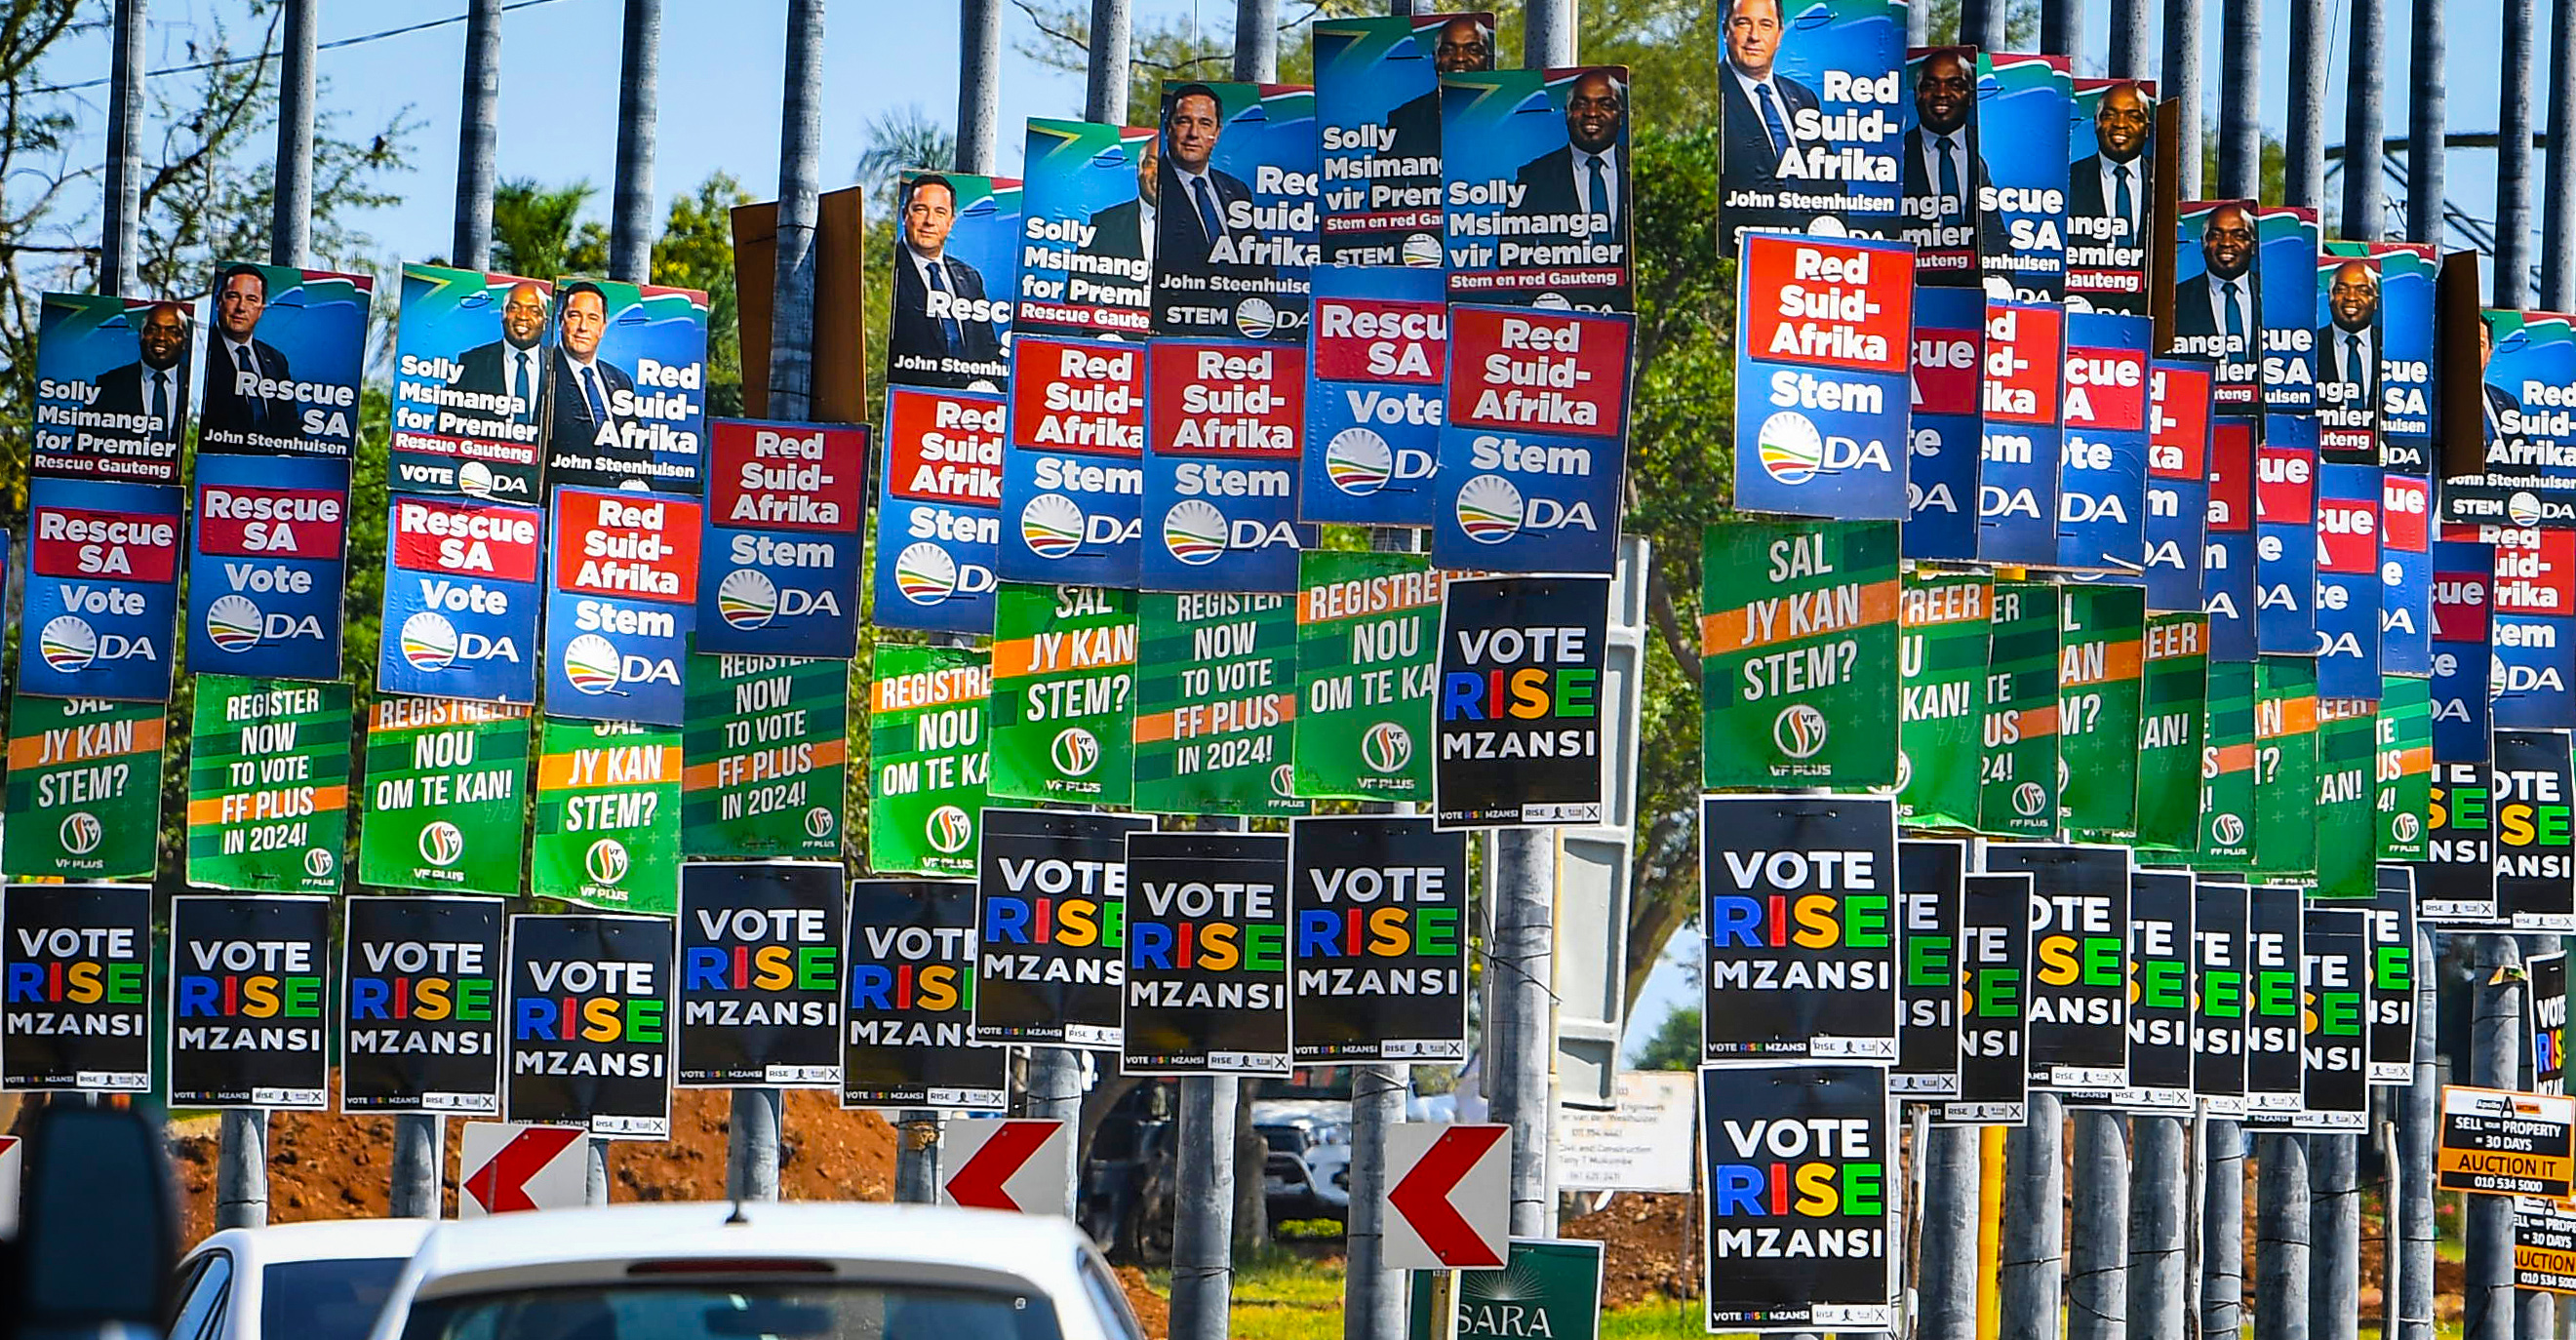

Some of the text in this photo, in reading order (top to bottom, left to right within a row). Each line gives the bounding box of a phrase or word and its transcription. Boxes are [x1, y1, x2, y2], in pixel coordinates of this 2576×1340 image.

[1823, 70, 1899, 103] Red
[1323, 125, 1397, 151] Solly
[1794, 108, 1898, 141] Suid-
[1775, 146, 1897, 181] Afrika
[1325, 187, 1366, 212] vir
[1448, 179, 1527, 210] Solly
[1725, 190, 1895, 213] John Steenhuisen
[1025, 217, 1097, 245] Solly
[1449, 212, 1609, 238] Msimanga
[2009, 219, 2063, 251] SA
[1450, 242, 1624, 268] vir Premier
[1022, 277, 1064, 299] for
[1450, 272, 1617, 290] Stem en red Gauteng
[1020, 302, 1090, 324] Rescue
[1166, 306, 1228, 325] STEM
[1500, 318, 1581, 354] Red
[400, 355, 464, 383] Solly
[636, 358, 701, 391] Red
[1060, 349, 1133, 380] Red
[1197, 350, 1273, 381] Red
[1366, 341, 1433, 377] SA
[1483, 353, 1591, 389] Suid-
[2263, 356, 2313, 386] SA
[39, 378, 100, 405] Solly
[234, 372, 354, 407] Rescue
[398, 381, 526, 416] Msimanga
[611, 389, 699, 422] Suid-
[1182, 383, 1286, 415] Suid-
[2384, 387, 2428, 415] SA
[38, 406, 163, 437] Msimanga
[302, 408, 351, 438] SA
[1472, 389, 1598, 426] Afrika
[203, 428, 346, 454] John Steenhuisen
[396, 407, 538, 444] for Premier
[594, 420, 698, 454] Afrika
[1173, 417, 1294, 450] Afrika
[36, 431, 177, 457] for Premier
[395, 433, 534, 465] Rescue Gauteng
[755, 431, 825, 459] Red
[1470, 435, 1591, 476] Stem
[35, 456, 171, 478] Rescue Gauteng
[399, 464, 529, 494] VOTE DA
[550, 453, 695, 479] John Steenhuisen
[739, 460, 834, 493] Suid-
[1174, 461, 1289, 497] Stem
[204, 490, 340, 522] Rescue
[598, 499, 664, 531] Red
[730, 493, 840, 526] Afrika
[1526, 497, 1599, 532] DA
[2453, 499, 2576, 519] STEM DA
[242, 522, 297, 551] SA
[583, 529, 673, 562] Suid-
[1230, 519, 1300, 549] DA
[730, 533, 835, 569] Stem
[1768, 533, 1833, 584] SAL
[224, 563, 312, 593] Vote
[575, 559, 680, 595] Afrika
[778, 588, 842, 616] DA
[1741, 583, 1860, 646] JY KAN
[263, 612, 325, 640] DA
[575, 600, 675, 638] Stem
[1457, 626, 1587, 665] VOTE
[620, 655, 681, 686] DA
[1743, 640, 1857, 702] STEM?
[2507, 664, 2565, 692] DA
[226, 688, 320, 722] REGISTER
[734, 675, 793, 716] NOW
[1026, 673, 1131, 723] STEM?
[1444, 666, 1597, 722] RISE
[1902, 681, 1970, 722] KAN!
[38, 719, 133, 765] JY KAN
[241, 722, 297, 756] NOW
[725, 709, 807, 748] TO VOTE
[918, 706, 978, 753] NOU
[415, 730, 474, 770] NOU
[1443, 729, 1596, 761] MZANSI
[229, 756, 310, 788] TO VOTE
[717, 742, 812, 789] FF PLUS
[882, 757, 953, 798] OM TE
[1792, 764, 1832, 776] PLUS
[38, 764, 130, 808] STEM?
[376, 769, 512, 811] OM TE KAN!
[721, 781, 806, 821] IN 2024!
[220, 785, 315, 825] FF PLUS
[1440, 811, 1463, 820] VOTE
[223, 823, 308, 855] IN 2024!
[1724, 849, 1875, 890] VOTE
[1141, 882, 1274, 920] VOTE
[696, 908, 825, 942] VOTE
[1713, 894, 1889, 949] RISE
[18, 927, 135, 959] VOTE
[1131, 922, 1285, 970] RISE
[7, 961, 143, 1004] RISE
[687, 945, 838, 992] RISE
[1713, 960, 1889, 992] MZANSI
[1129, 980, 1284, 1010] MZANSI
[7, 1013, 142, 1037] MZANSI
[686, 1000, 837, 1027] MZANSI
[1708, 1043, 1737, 1052] VOTE
[1764, 1043, 1806, 1052] MZANSI
[1813, 1041, 1836, 1051] RISE
[846, 1091, 869, 1100] VOTE
[2454, 1117, 2483, 1130] SELL
[2502, 1121, 2561, 1137] PROPERTY
[2485, 1135, 2501, 1148] 30
[2503, 1136, 2532, 1151] DAYS
[2458, 1154, 2556, 1177] AUCTION IT
[2474, 1176, 2543, 1192] 010 534 5000
[2531, 1233, 2572, 1248] 30 DAYS
[2520, 1272, 2556, 1285] 010 534
